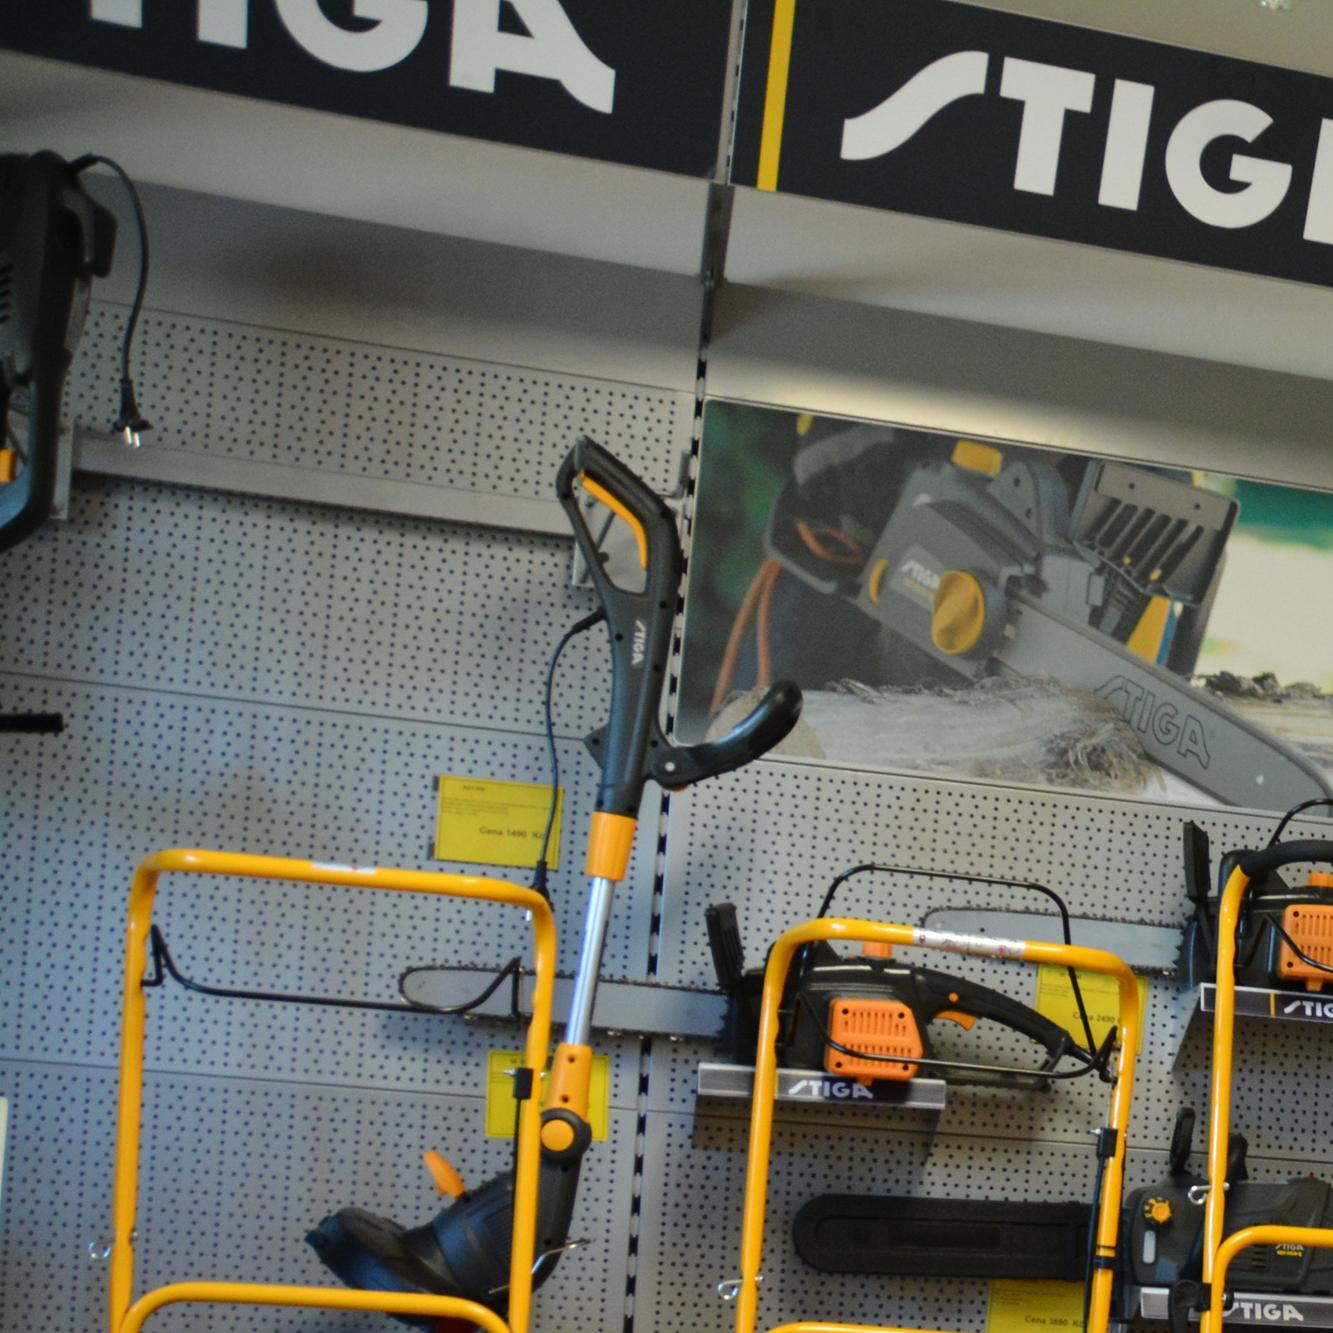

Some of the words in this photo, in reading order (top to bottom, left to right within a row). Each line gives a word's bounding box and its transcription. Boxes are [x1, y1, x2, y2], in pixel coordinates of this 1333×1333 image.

[632, 619, 646, 666] STIGA
[1094, 674, 1211, 770] STIGA
[789, 1079, 874, 1099] STIGA
[1222, 1302, 1304, 1321] STIGA
